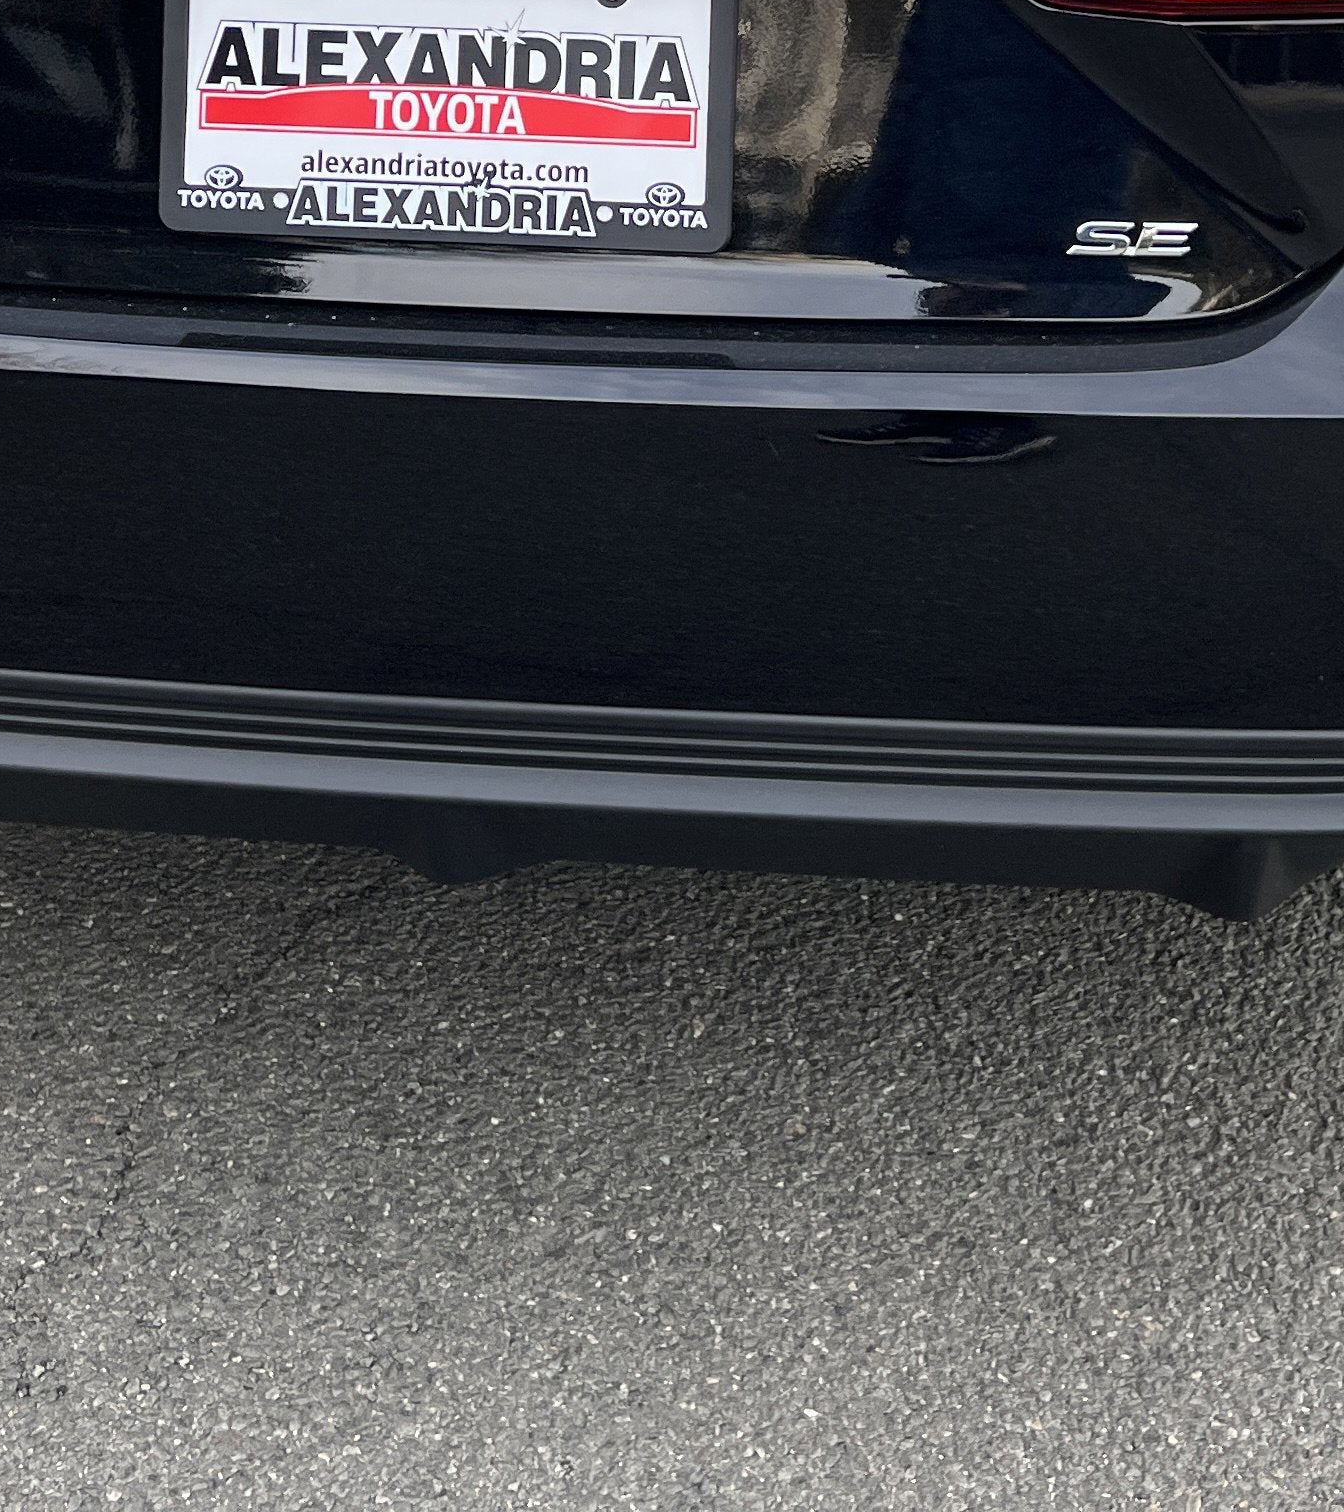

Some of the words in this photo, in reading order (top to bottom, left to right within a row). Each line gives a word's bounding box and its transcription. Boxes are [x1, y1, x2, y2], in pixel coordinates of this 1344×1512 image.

[203, 22, 696, 105] ALEXANDRIA
[368, 90, 526, 135] TOYOTA
[300, 148, 589, 186] alexandriatoyota.com
[176, 188, 265, 211] TOYOTA
[290, 182, 593, 235] ALEXANDRIA
[619, 206, 708, 229] TOYOTA
[1065, 220, 1200, 257] SE
